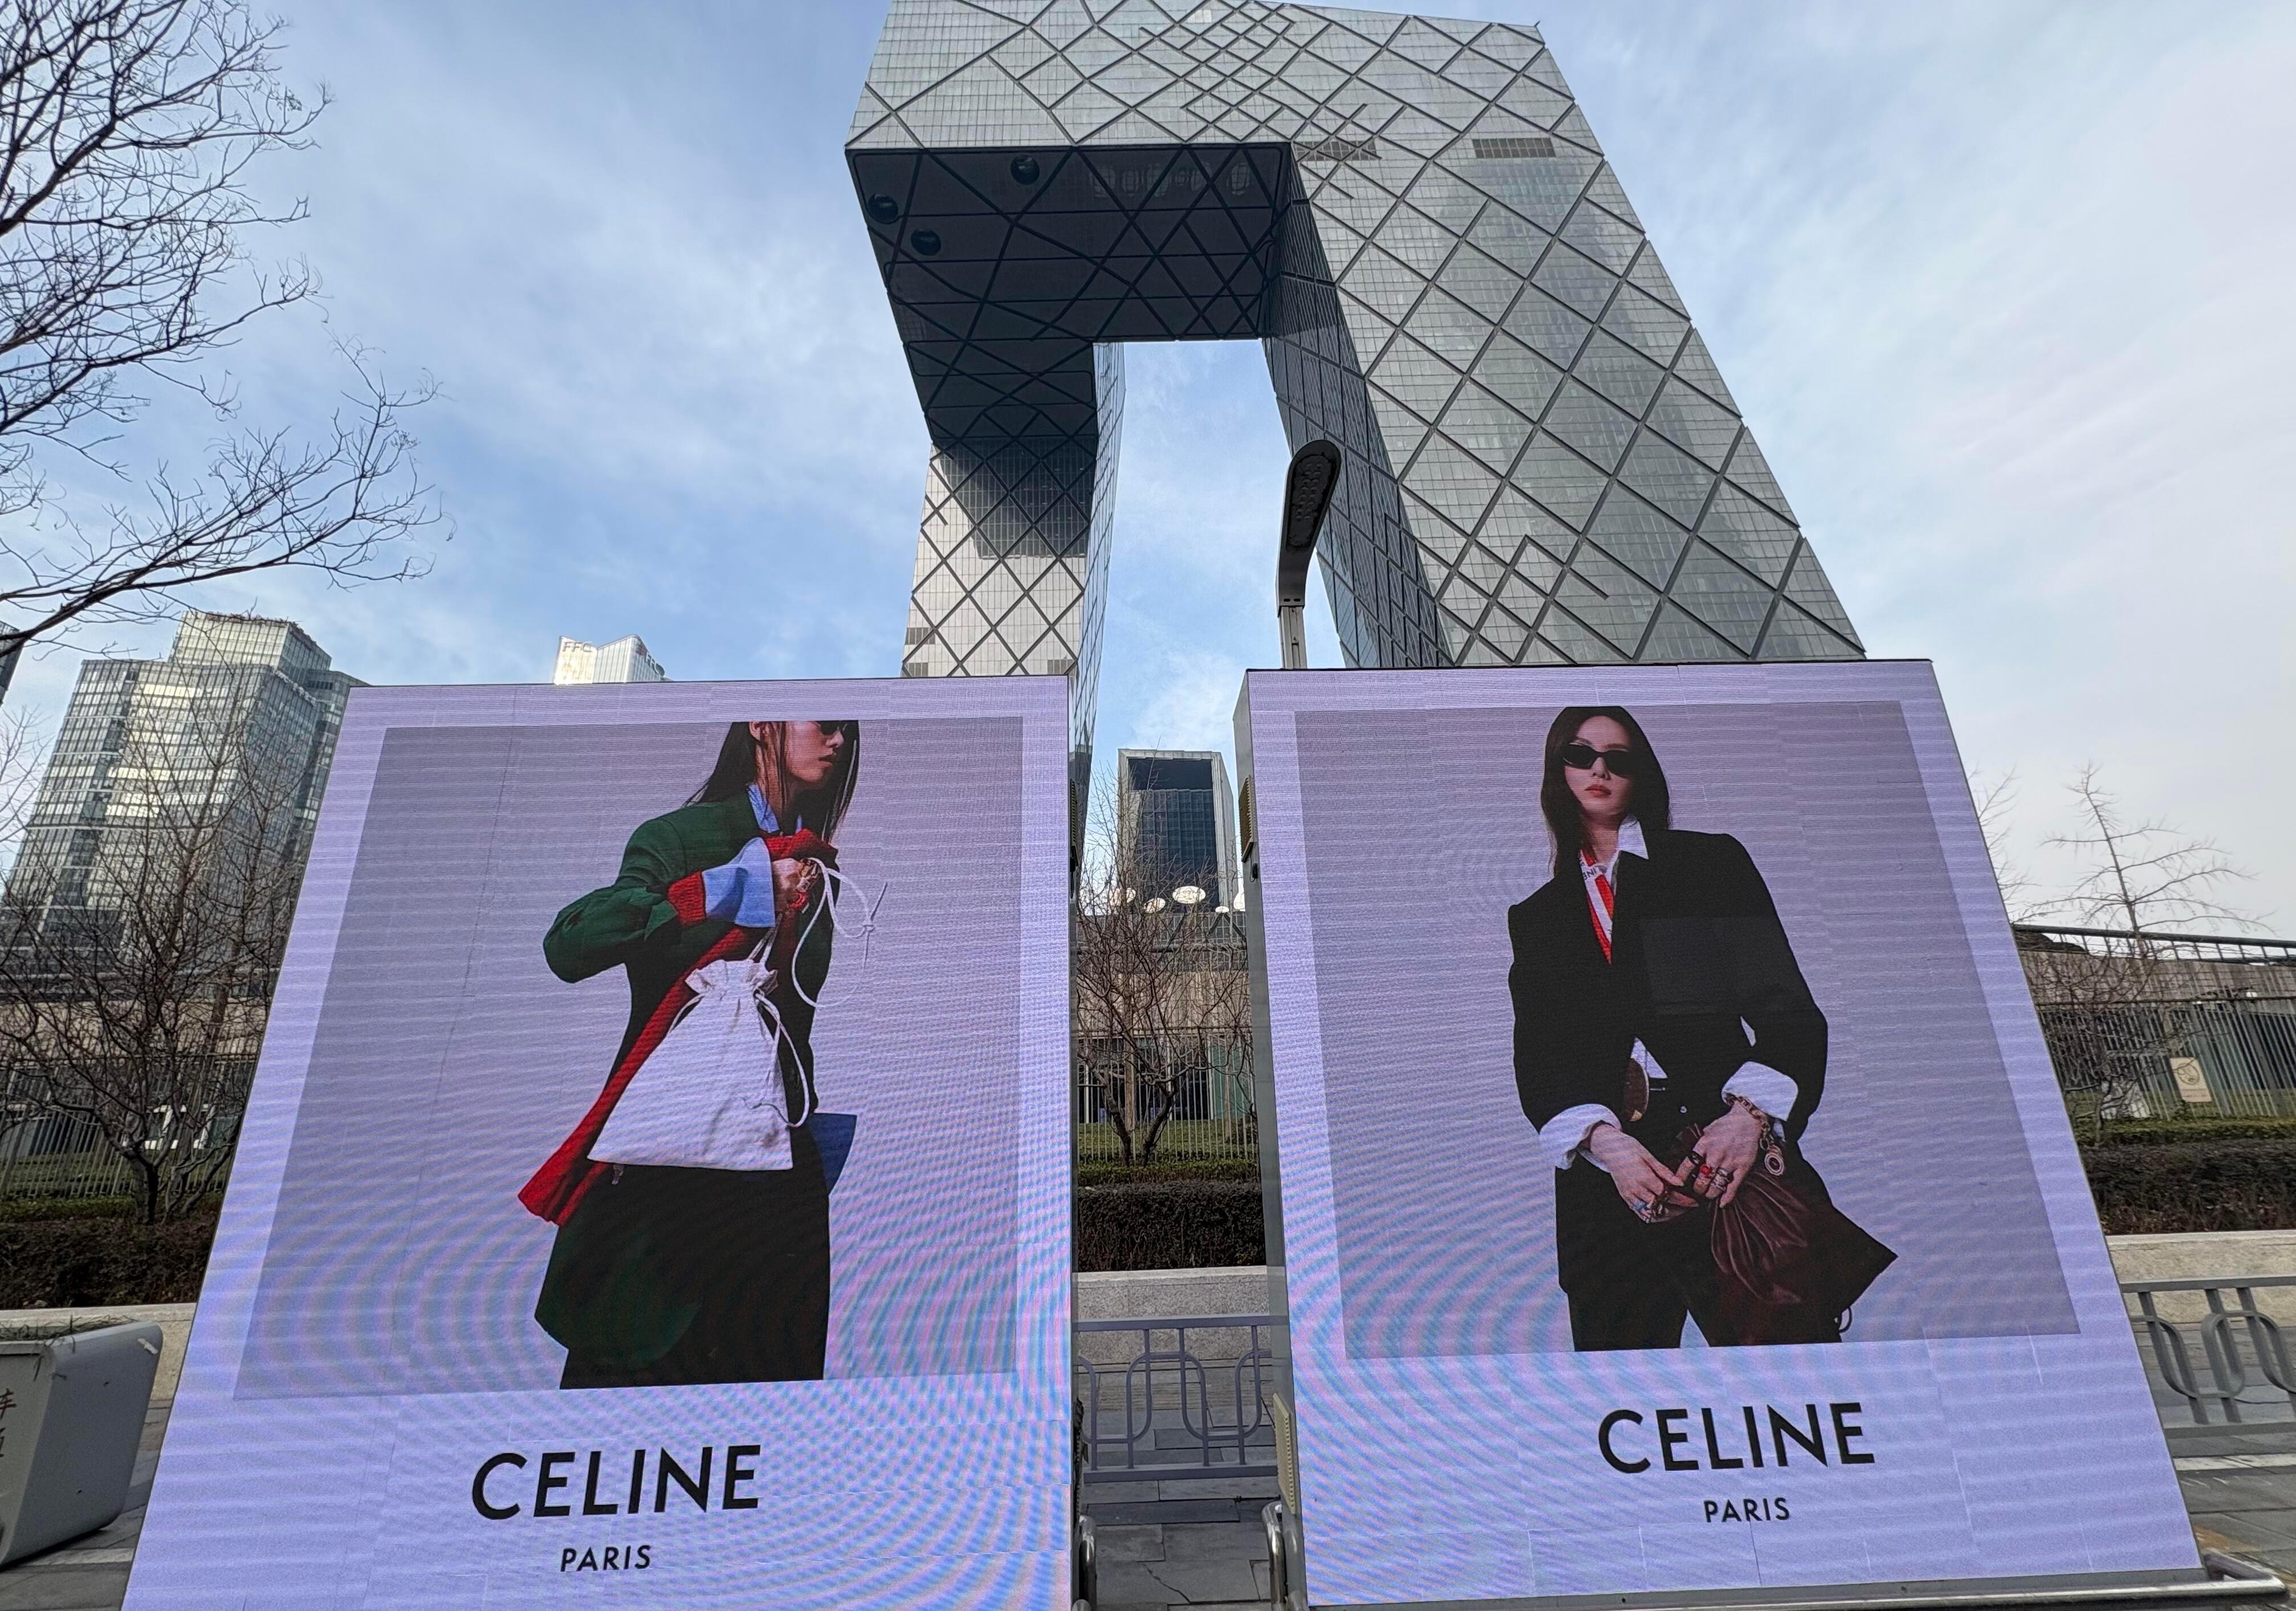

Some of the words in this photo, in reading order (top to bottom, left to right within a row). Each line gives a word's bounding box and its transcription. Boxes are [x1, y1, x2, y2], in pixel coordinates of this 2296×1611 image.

[563, 641, 593, 652] FFC
[1598, 1402, 1875, 1474] CELINE
[471, 1445, 760, 1520] CELINE
[1703, 1497, 1790, 1523] PARIS
[560, 1545, 652, 1572] PARIS
